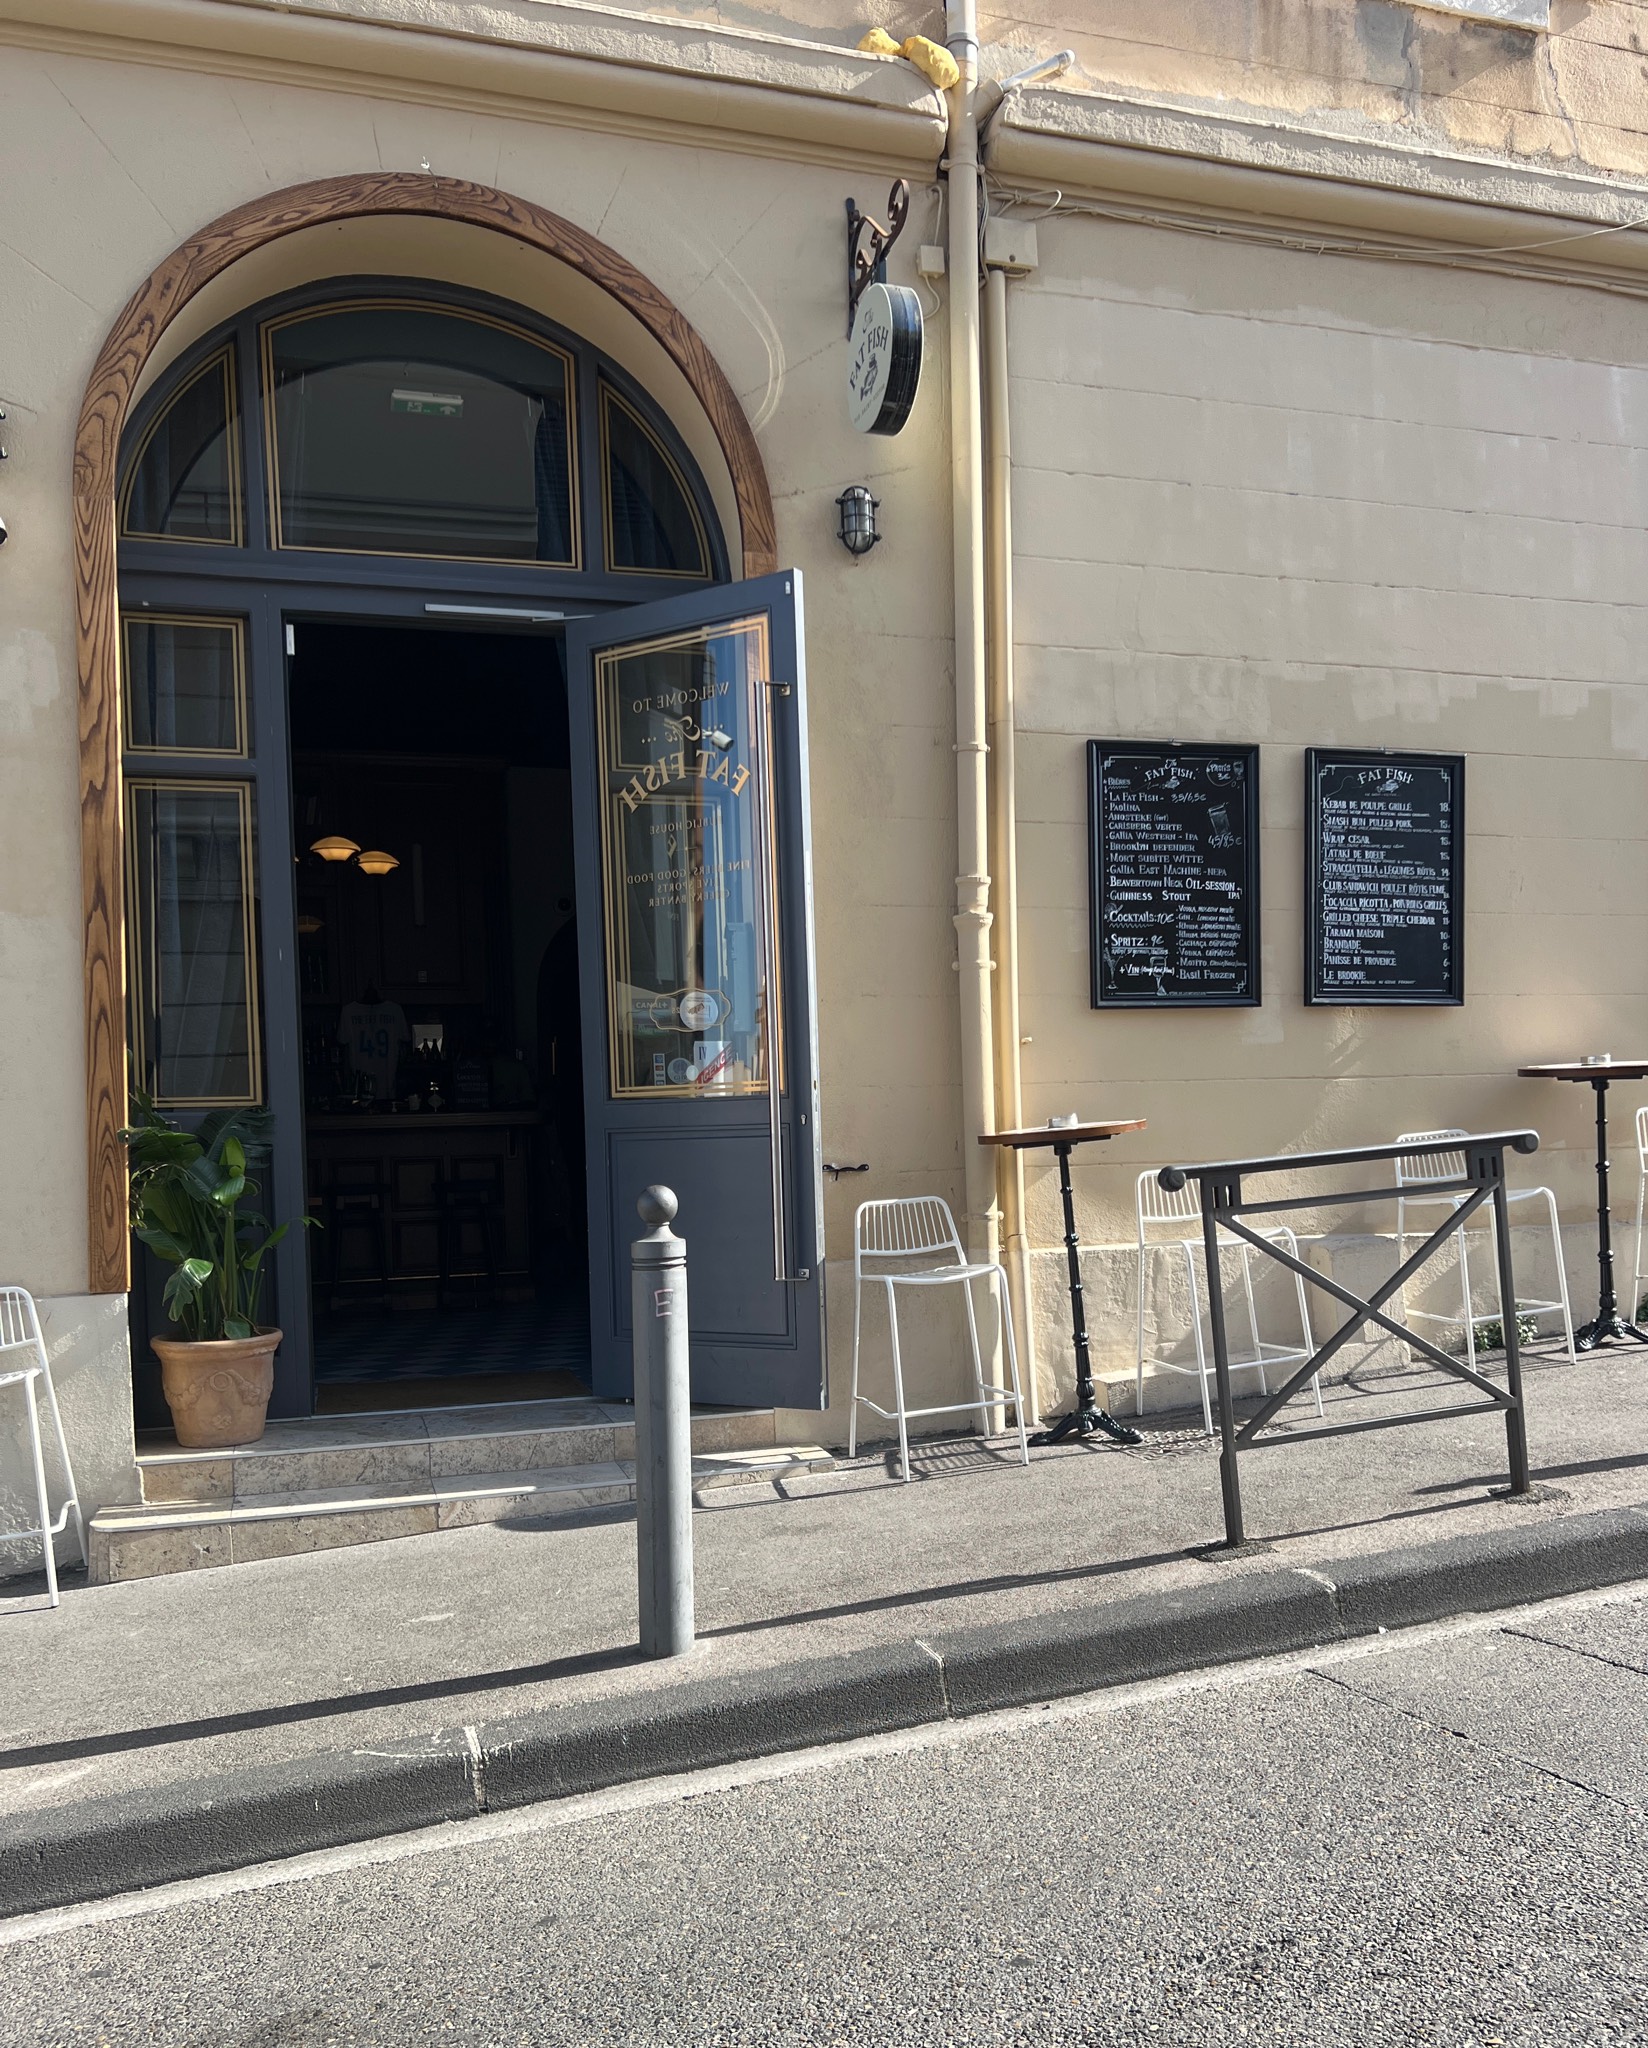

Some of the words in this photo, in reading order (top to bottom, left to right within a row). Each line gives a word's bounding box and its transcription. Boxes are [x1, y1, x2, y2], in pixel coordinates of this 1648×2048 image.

[850, 343, 865, 390] FAT
[868, 326, 889, 352] FISH
[1145, 767, 1165, 781] FAT
[1171, 767, 1194, 779] FISH
[1358, 770, 1381, 784] FAT
[1386, 768, 1412, 784] FISH
[1110, 793, 1120, 801] LA
[1123, 793, 1137, 801] FAT
[1323, 798, 1346, 809] KEBAB
[1360, 802, 1386, 810] POULPE
[1324, 815, 1349, 826] SMASH
[1352, 818, 1366, 826] BUN
[1369, 819, 1393, 827] PULLED
[1396, 819, 1412, 827] PORK
[1323, 832, 1345, 843] WRAP
[1110, 853, 1135, 862] MORT
[1173, 855, 1204, 863] WITTE
[1322, 847, 1350, 858] TATAKI
[1353, 850, 1361, 858] DE
[1139, 866, 1159, 875] EAST
[1164, 865, 1201, 875] MACHINE
[1323, 861, 1379, 874] STRACCIATELLA
[1110, 876, 1162, 887] BEAVERTOWN
[1323, 880, 1342, 890] CLUB
[1343, 881, 1379, 891] SANDWICH
[1381, 884, 1407, 893] POULET
[1110, 892, 1152, 900] GUINNESS
[1162, 891, 1191, 901] STOUT
[1324, 894, 1357, 906] FOCACCIA
[1359, 897, 1388, 908] RICOTTA
[1323, 911, 1351, 922] GRILLED
[1353, 914, 1378, 922] CHEESE
[1381, 914, 1405, 924] TRIPLE
[1407, 916, 1435, 925] CHEDDAR
[1324, 926, 1354, 937] TARAMA
[1357, 928, 1384, 938] MAISON
[1324, 938, 1361, 949] BRANDADE
[1324, 953, 1351, 964] PANISSE
[1354, 957, 1362, 965] DE
[1365, 958, 1397, 966] PROVENCE
[1125, 964, 1139, 974] VIN
[1204, 969, 1235, 979] FROZEN
[1324, 968, 1334, 979] LE
[635, 1001, 668, 1009] CANAL+
